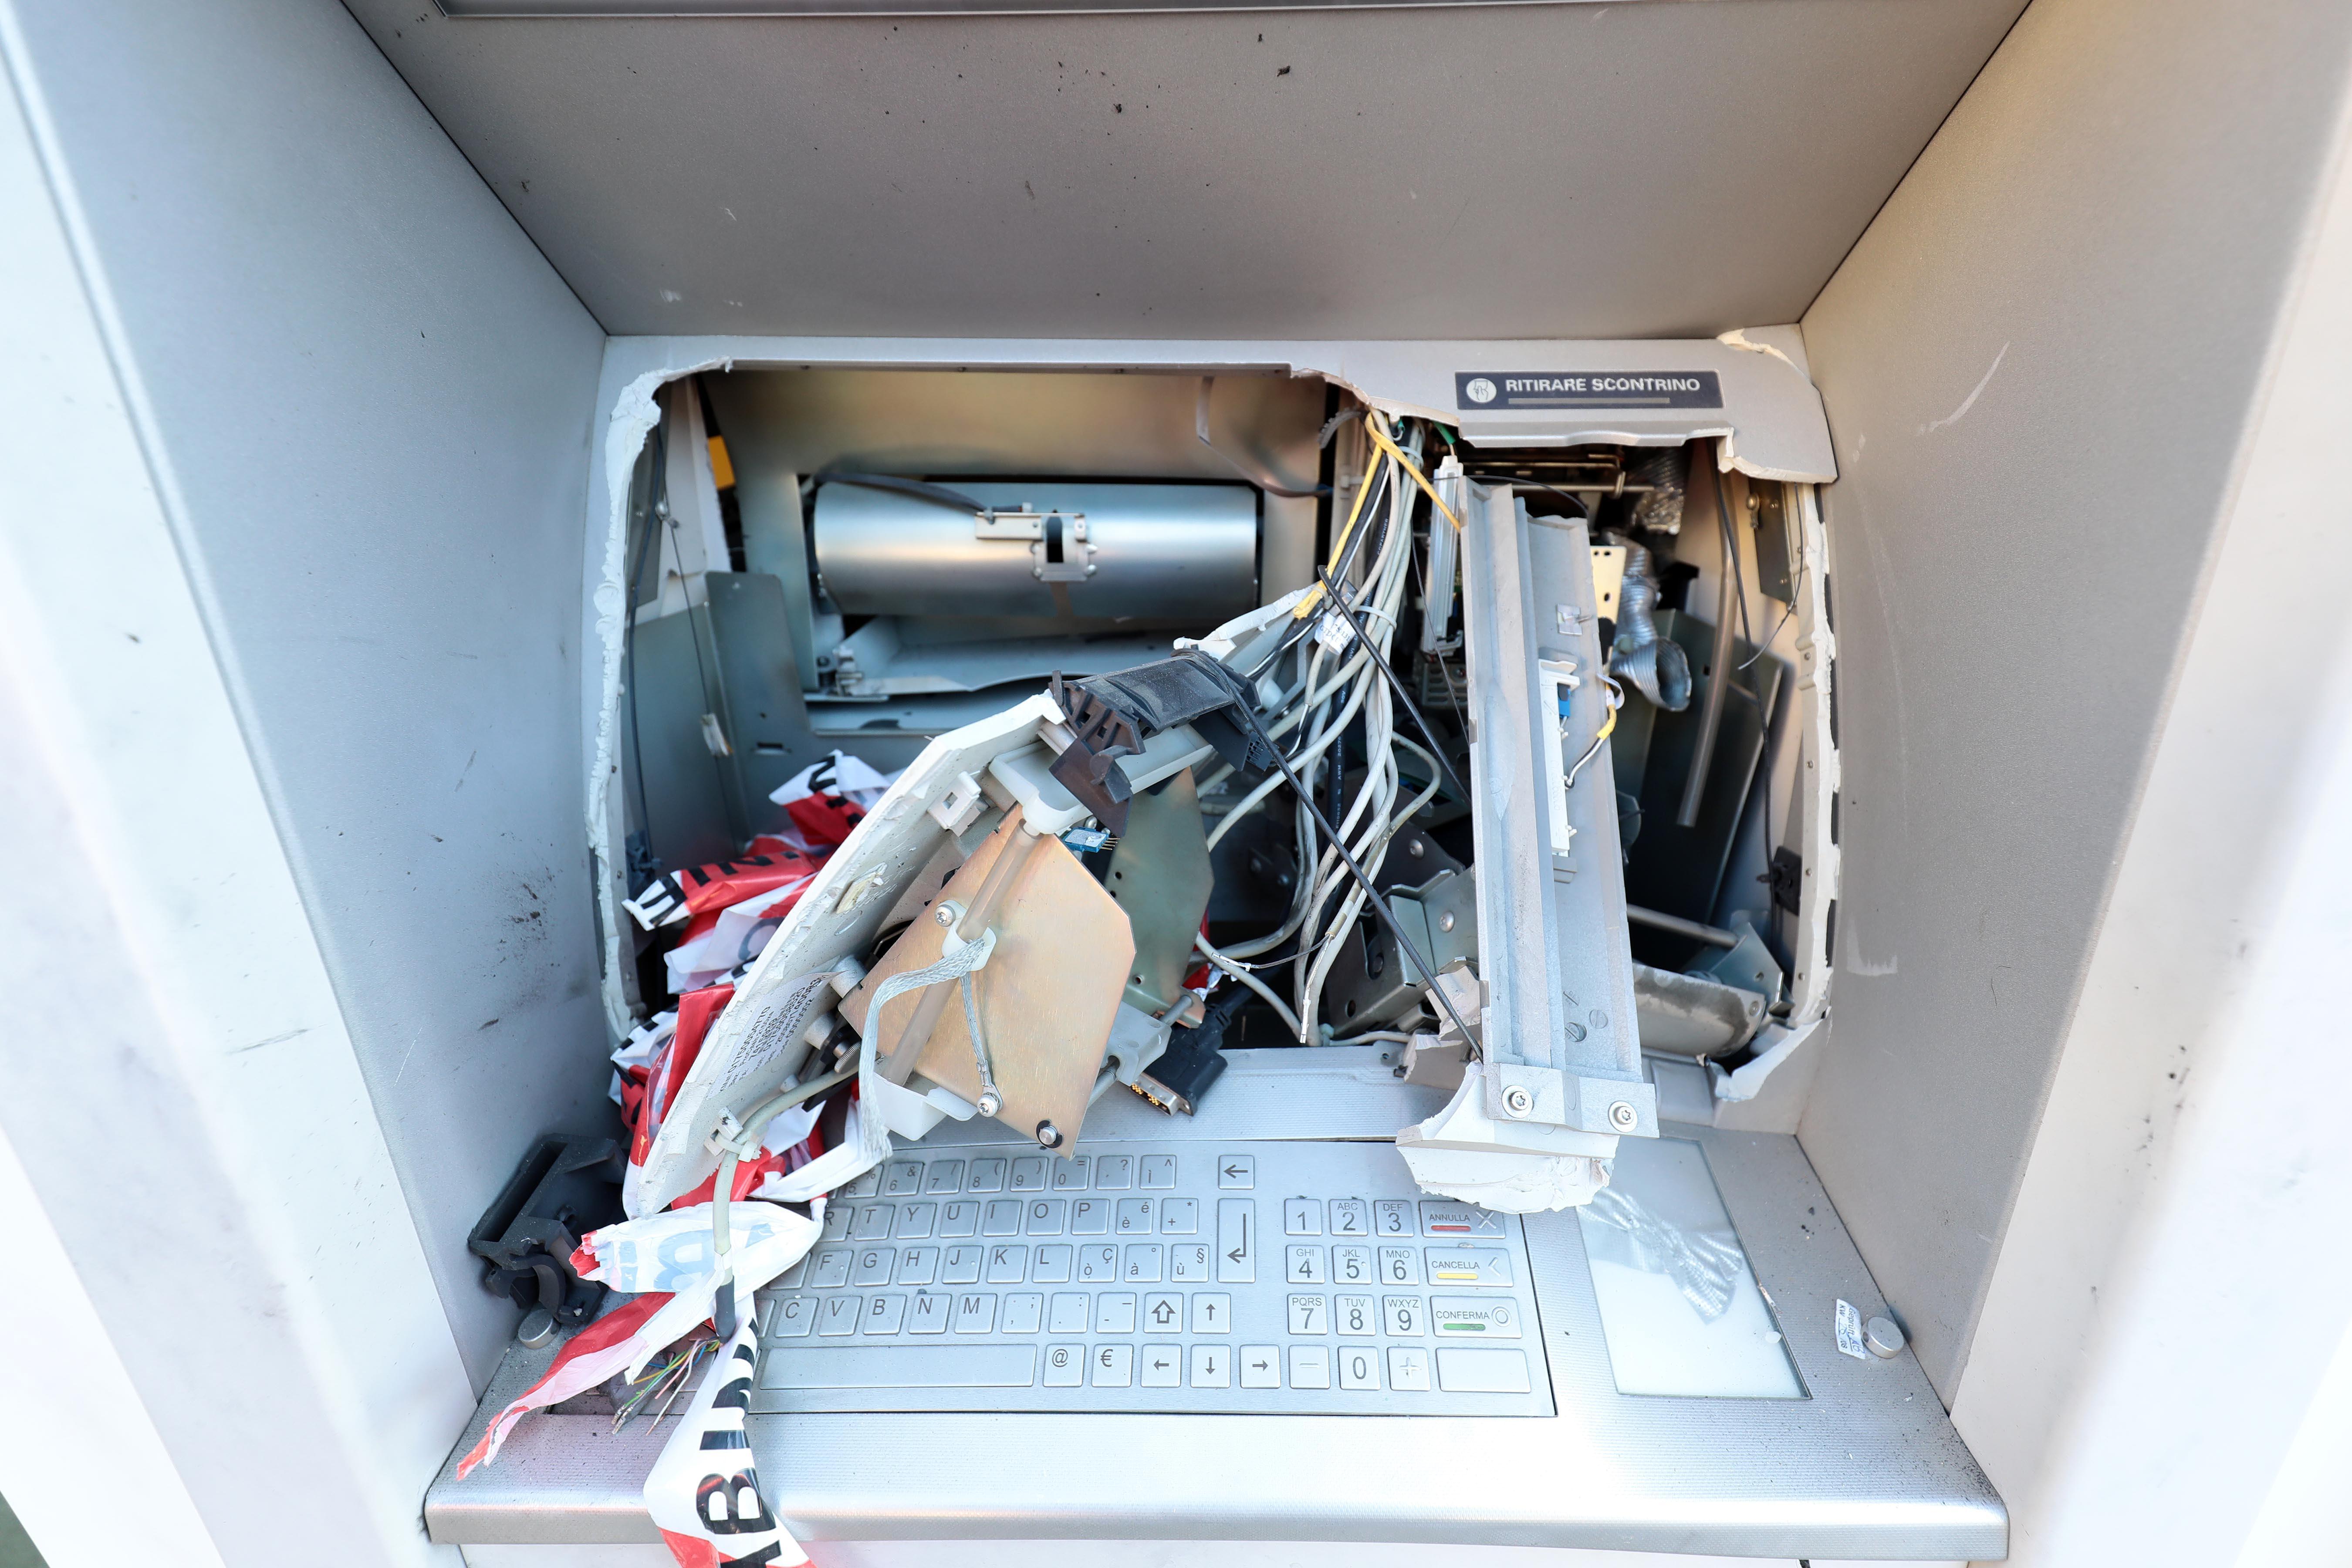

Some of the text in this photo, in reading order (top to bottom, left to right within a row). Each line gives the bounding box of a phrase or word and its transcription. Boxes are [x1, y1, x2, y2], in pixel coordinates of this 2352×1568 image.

[1505, 378, 1700, 392] RITIRARE SCONTRINO
[847, 1182, 857, 1193] 5
[889, 1179, 898, 1191] 6
[932, 1178, 939, 1189] 7
[973, 1176, 980, 1188] 8
[1015, 1175, 1024, 1186] 9
[823, 1210, 835, 1226] R
[865, 1209, 877, 1224] T
[907, 1206, 920, 1222] Y
[947, 1205, 961, 1220] U
[1034, 1203, 1048, 1219] O
[1078, 1203, 1091, 1218] P
[1337, 1202, 1403, 1211] ABC DEF
[1298, 1211, 1402, 1232] 1 2 3
[819, 1254, 833, 1270] F
[863, 1253, 877, 1268] G
[906, 1251, 920, 1267] H
[950, 1249, 960, 1265] J
[994, 1249, 1008, 1265] K
[1039, 1248, 1049, 1264] L
[1296, 1248, 1410, 1259] GHI JKL MNO
[1298, 1257, 1406, 1280] 4 5 6
[1431, 1260, 1480, 1269] CANCELLA
[785, 1302, 800, 1319] C
[831, 1300, 845, 1317] V
[872, 1299, 885, 1315] B
[918, 1298, 933, 1315] N
[963, 1297, 980, 1314] M
[1292, 1297, 1419, 1308] PQRS TUV WXYZ
[1839, 1304, 1846, 1317] KW
[1301, 1308, 1412, 1331] 7 8 9
[1436, 1311, 1490, 1319] CONFERMA
[1100, 1348, 1113, 1368] €
[1352, 1356, 1366, 1380] 0
